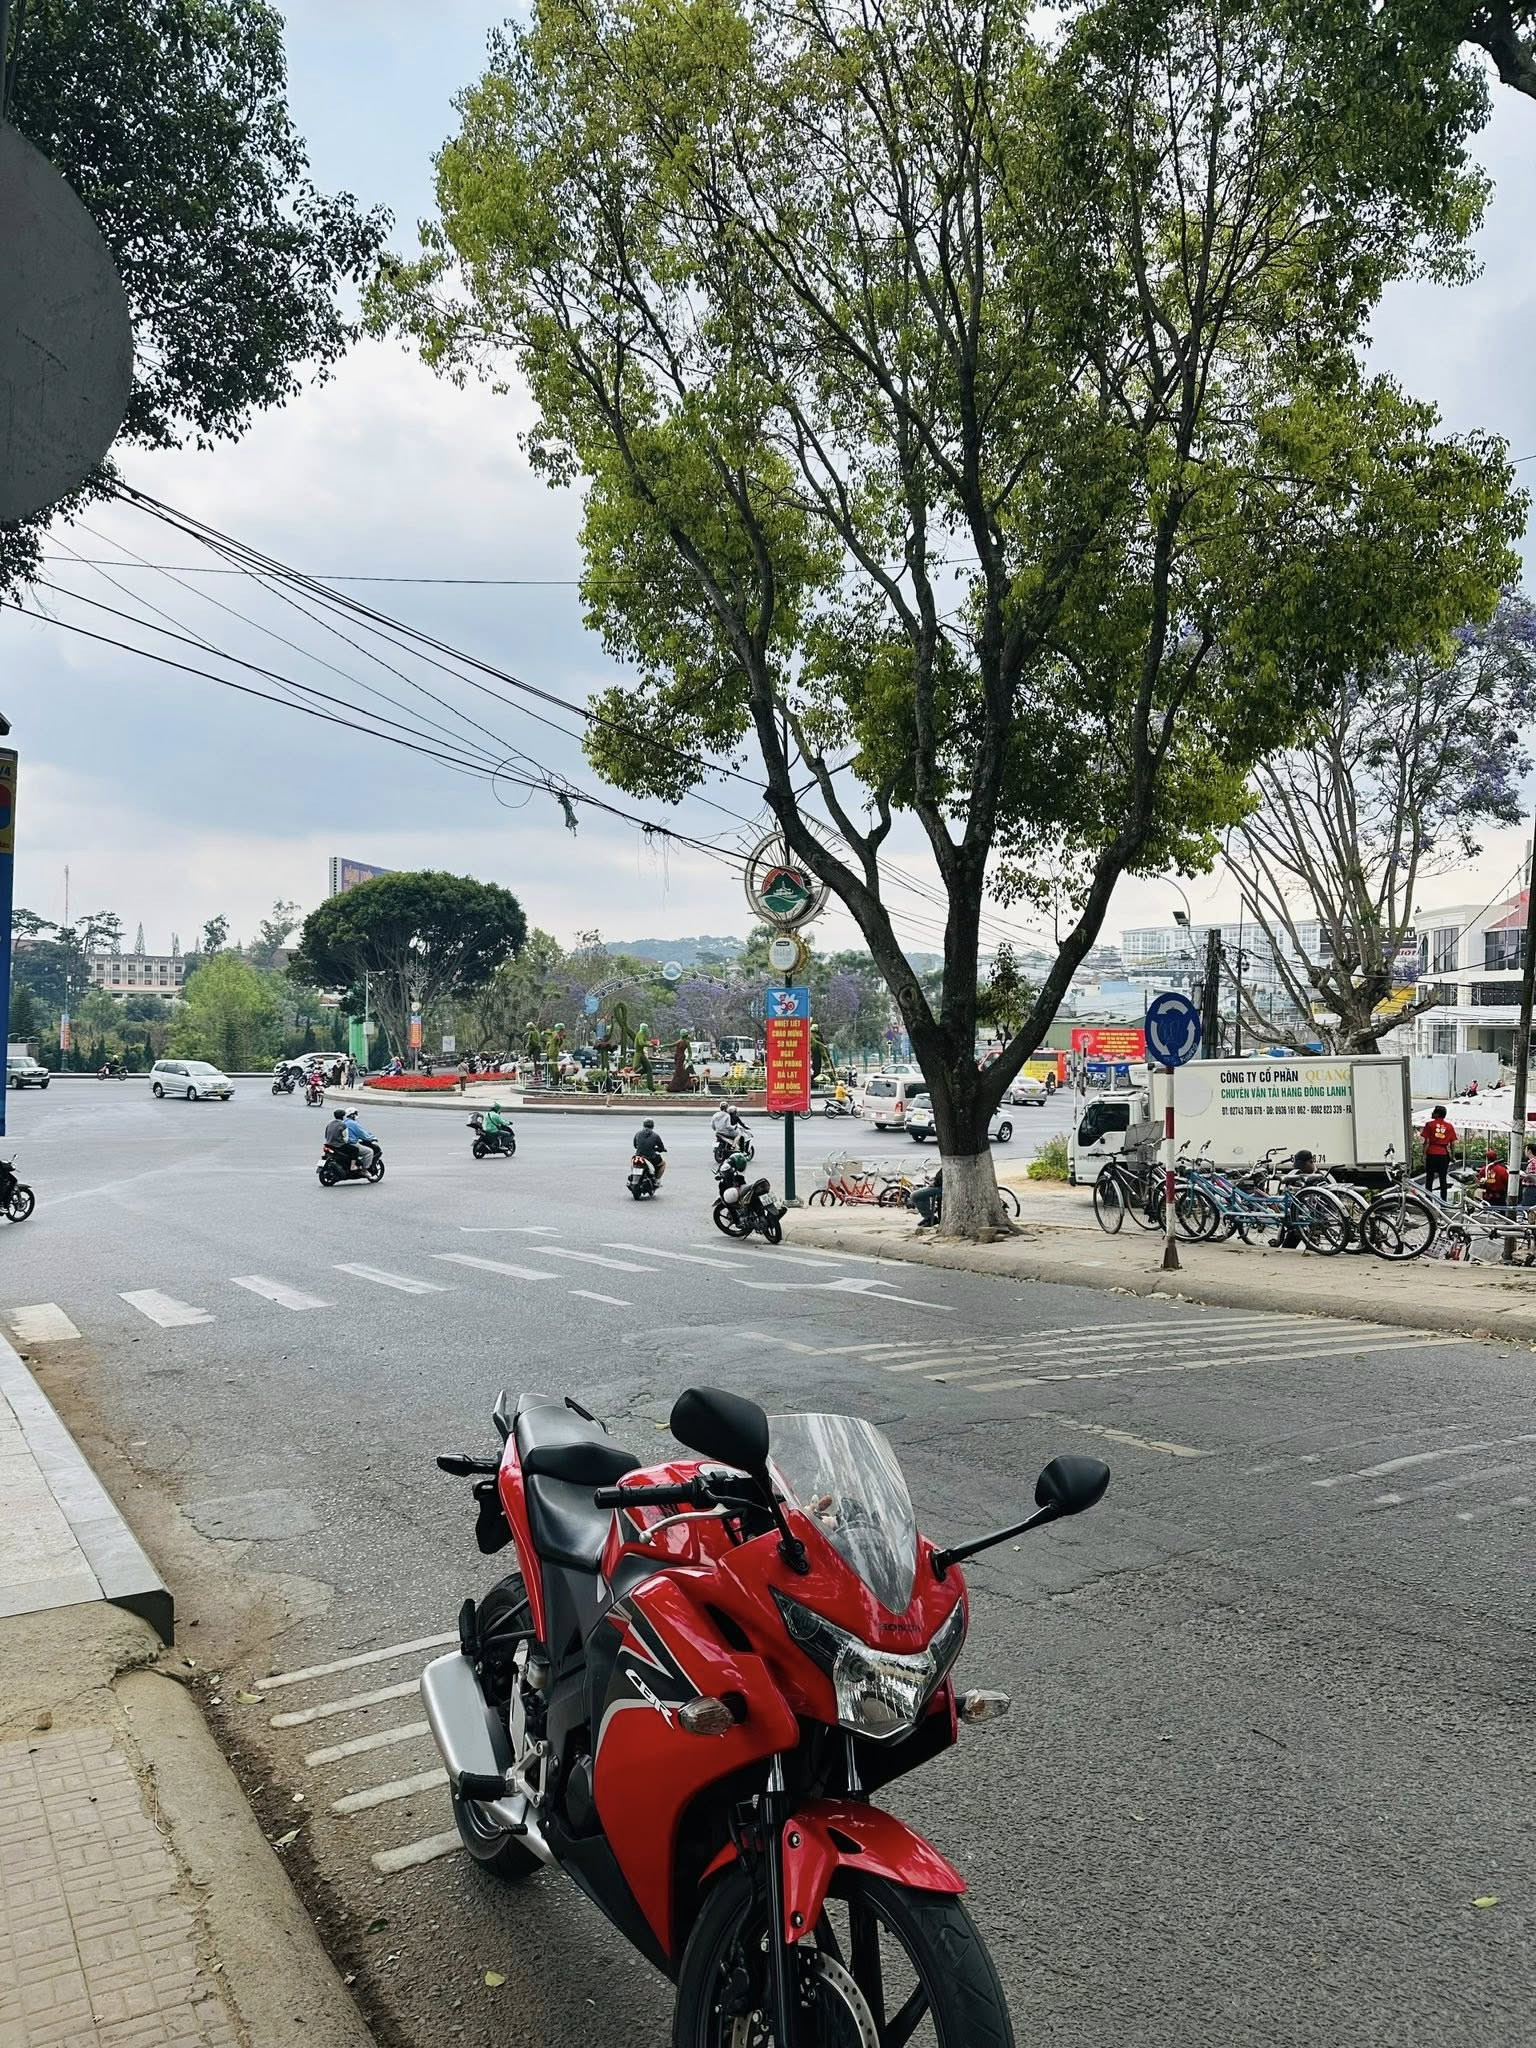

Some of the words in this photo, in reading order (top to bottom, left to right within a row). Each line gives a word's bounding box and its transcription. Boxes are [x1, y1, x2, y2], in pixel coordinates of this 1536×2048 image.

[1220, 1070, 1244, 1083] CÔNG
[1247, 1072, 1256, 1082] TY
[1260, 1066, 1271, 1082] CỔ
[1274, 1067, 1298, 1082] PHẦN
[1305, 1069, 1350, 1084] QUANG
[1221, 1086, 1249, 1098] CHUYÊN
[624, 1668, 674, 1730] CBR
